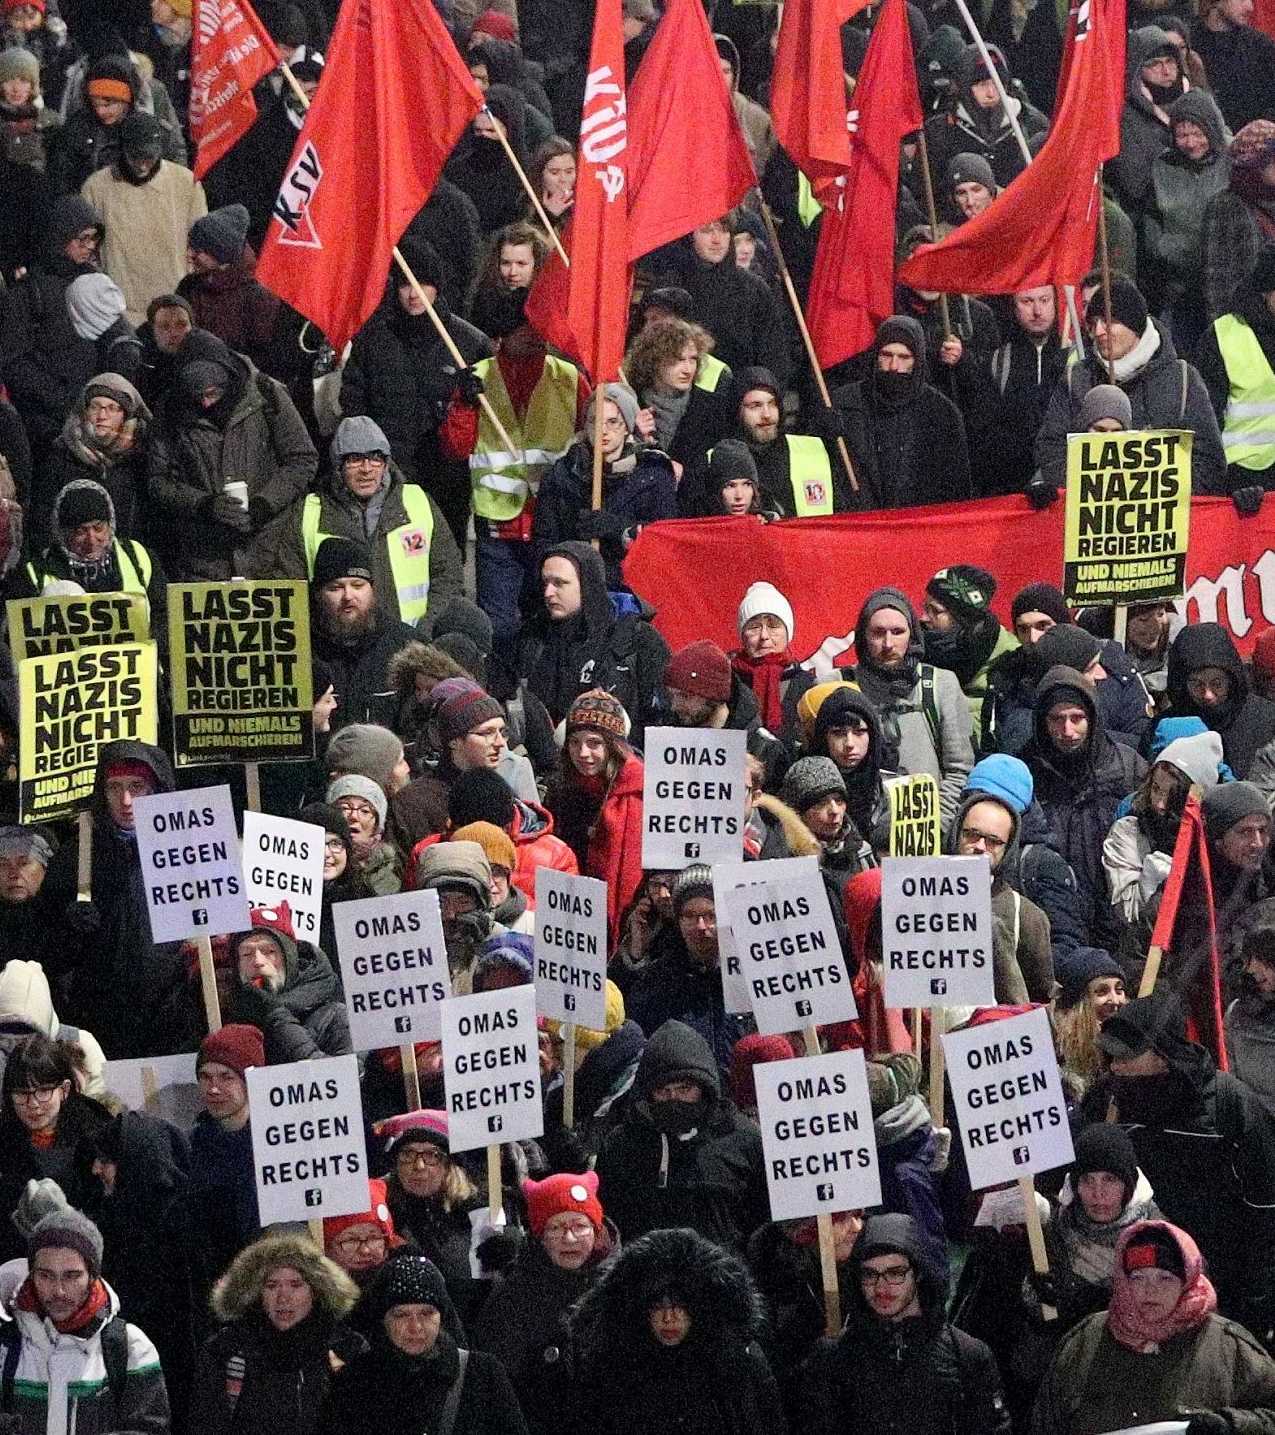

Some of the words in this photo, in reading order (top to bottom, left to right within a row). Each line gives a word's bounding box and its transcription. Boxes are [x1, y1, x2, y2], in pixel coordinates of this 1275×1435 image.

[272, 146, 321, 232] KSV
[1080, 436, 1180, 472] LASST
[1079, 468, 1180, 504] NAZIS
[1078, 500, 1179, 537] NICHT
[1078, 531, 1177, 558] REGIEREN
[1075, 575, 1176, 595] AUFMARSCHIEREN!
[1077, 565, 1110, 581] UND
[1113, 557, 1177, 578] NIEMALS
[21, 599, 133, 639] LASST
[182, 587, 295, 622] LASST
[184, 620, 298, 654] NAZIS
[35, 649, 142, 694] LASST
[186, 654, 298, 688] NICHT
[35, 677, 142, 724] NAZIS
[187, 687, 299, 710] REGIEREN
[35, 707, 142, 755] NICHT
[188, 733, 303, 748] AUFMARSCHIEREN!
[189, 718, 226, 734] UND
[228, 716, 302, 733] NIEMALS
[35, 743, 96, 775] REGIE
[662, 746, 727, 766] OMAS
[34, 778, 71, 796] UND
[655, 781, 733, 801] GEGEN
[895, 782, 934, 821] LASST
[152, 807, 215, 834] OMAS
[648, 813, 738, 836] RECHTS
[259, 833, 310, 861] OMAS
[895, 820, 935, 857] NAZIS
[152, 841, 228, 870] GEGEN
[152, 875, 241, 906] RECHTS
[251, 867, 313, 896] GEGEN
[902, 875, 971, 898] OMAS
[548, 889, 594, 918] OMAS
[746, 895, 812, 927] OMAS
[354, 912, 422, 941] OMAS
[542, 923, 598, 955] GEGEN
[894, 911, 978, 935] GEGEN
[353, 946, 434, 976] GEGEN
[749, 930, 827, 963] GEGEN
[889, 948, 987, 971] RECHTS
[537, 958, 603, 993] RECHTS
[752, 963, 843, 1000] RECHTS
[352, 981, 447, 1013] RECHTS
[457, 1007, 520, 1037] OMAS
[454, 1043, 528, 1075] GEGEN
[966, 1034, 1035, 1071] OMAS
[268, 1078, 340, 1108] OMAS
[451, 1078, 537, 1114] RECHTS
[777, 1072, 848, 1104] OMAS
[966, 1070, 1049, 1110] GEGEN
[264, 1114, 351, 1147] GEGEN
[773, 1109, 860, 1142] GEGEN
[966, 1105, 1063, 1150] RECHTS
[261, 1151, 362, 1187] RECHTS
[772, 1146, 872, 1182] RECHTS
